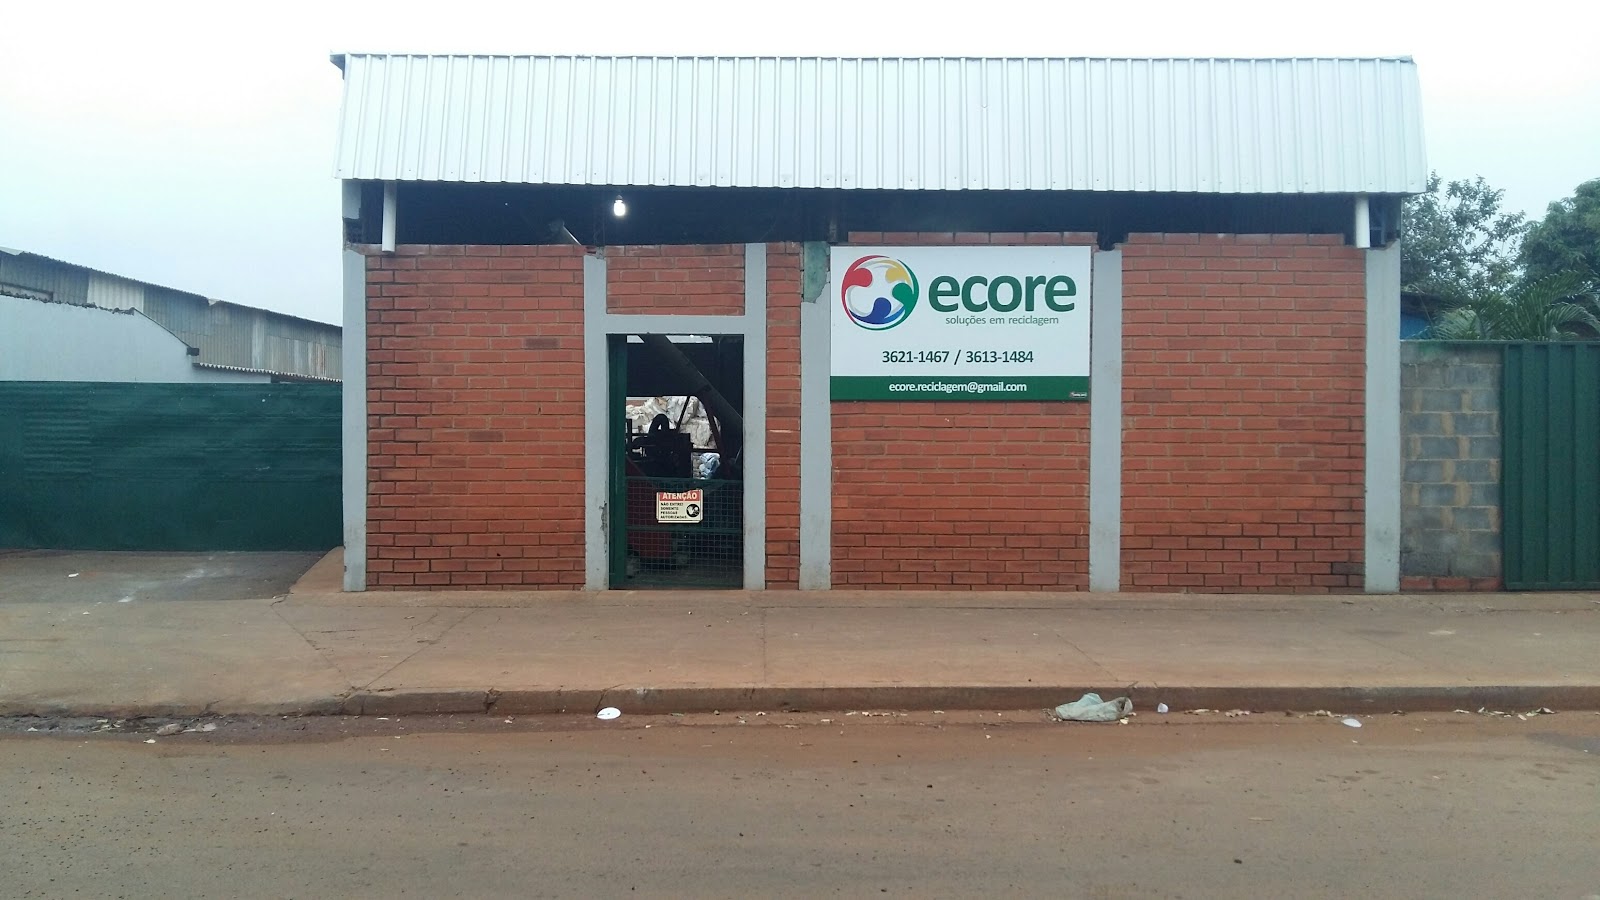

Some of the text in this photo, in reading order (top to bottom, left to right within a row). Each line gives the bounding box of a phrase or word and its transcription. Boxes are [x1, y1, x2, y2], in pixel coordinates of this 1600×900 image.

[928, 275, 1077, 313] ecore
[945, 315, 1059, 327] soluções em reciclagem
[882, 350, 950, 363] 3621-1467
[965, 350, 1034, 363] 3613-1484
[889, 381, 1027, 393] ecore.reciclagem@gmail.com
[662, 492, 698, 501] ATENÇÃO
